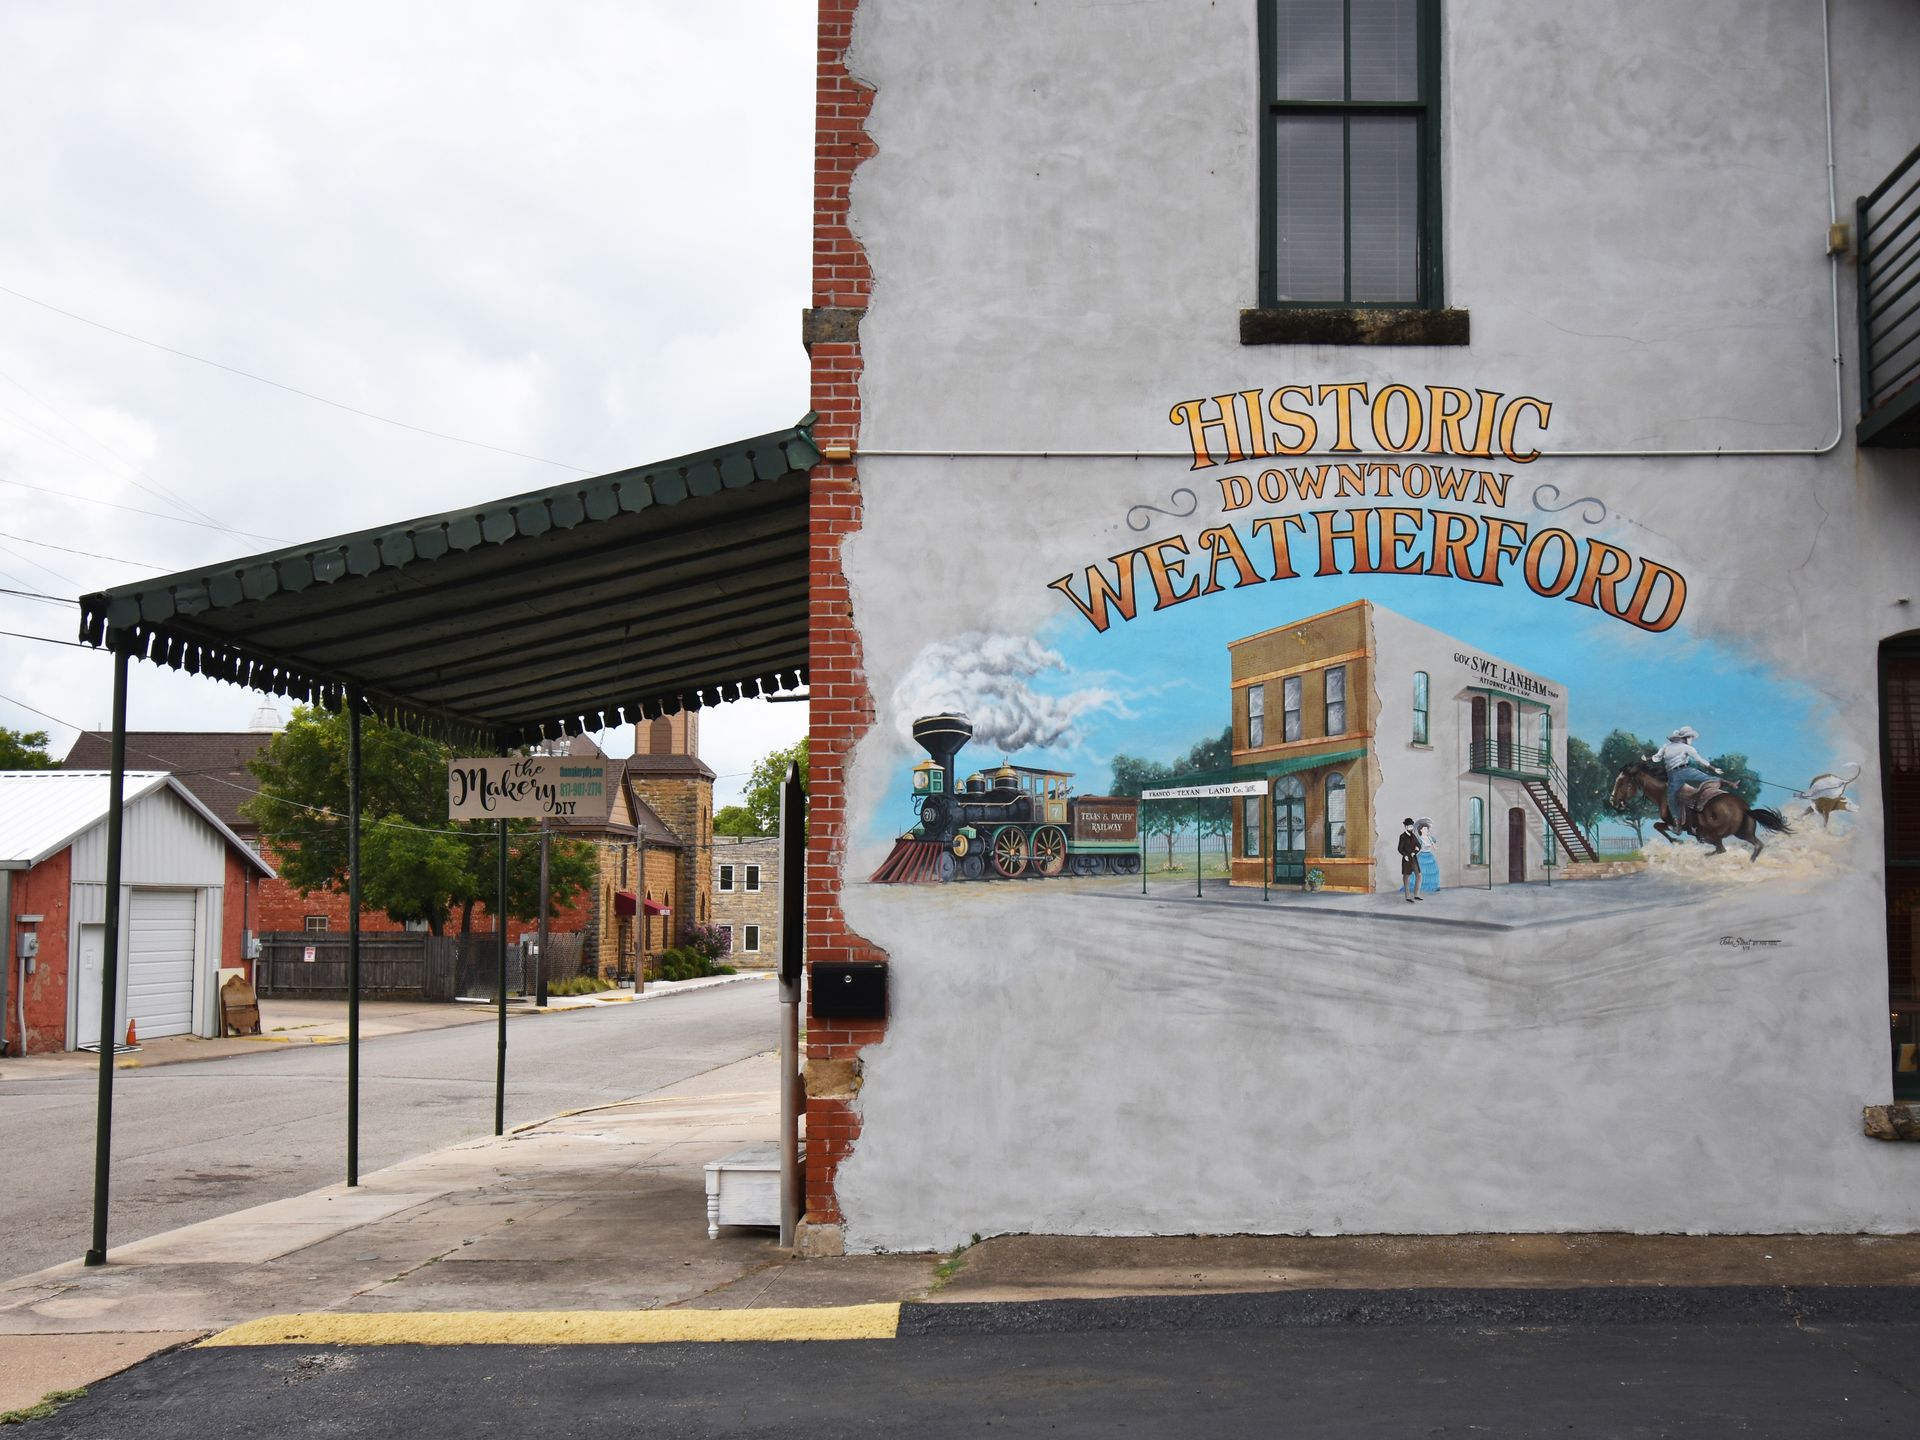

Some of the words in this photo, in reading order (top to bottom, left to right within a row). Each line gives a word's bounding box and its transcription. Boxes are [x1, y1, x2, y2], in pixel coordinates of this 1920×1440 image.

[1169, 382, 1552, 471] HISTORIC
[1216, 463, 1513, 512] DOWNTOWN
[1047, 507, 1688, 633] WEATHERFORD
[1480, 677, 1507, 690] ATTORNEY
[1503, 668, 1547, 696] LANHAM
[510, 758, 545, 778] the
[451, 768, 555, 812] Makery
[1208, 785, 1231, 795] LAND
[555, 801, 577, 815] DIY
[1051, 808, 1059, 818] 7
[1080, 812, 1101, 821] TEXAS
[1102, 813, 1110, 821] &
[1111, 812, 1134, 821] PACIFIC
[1091, 823, 1122, 833] RAILWAY
